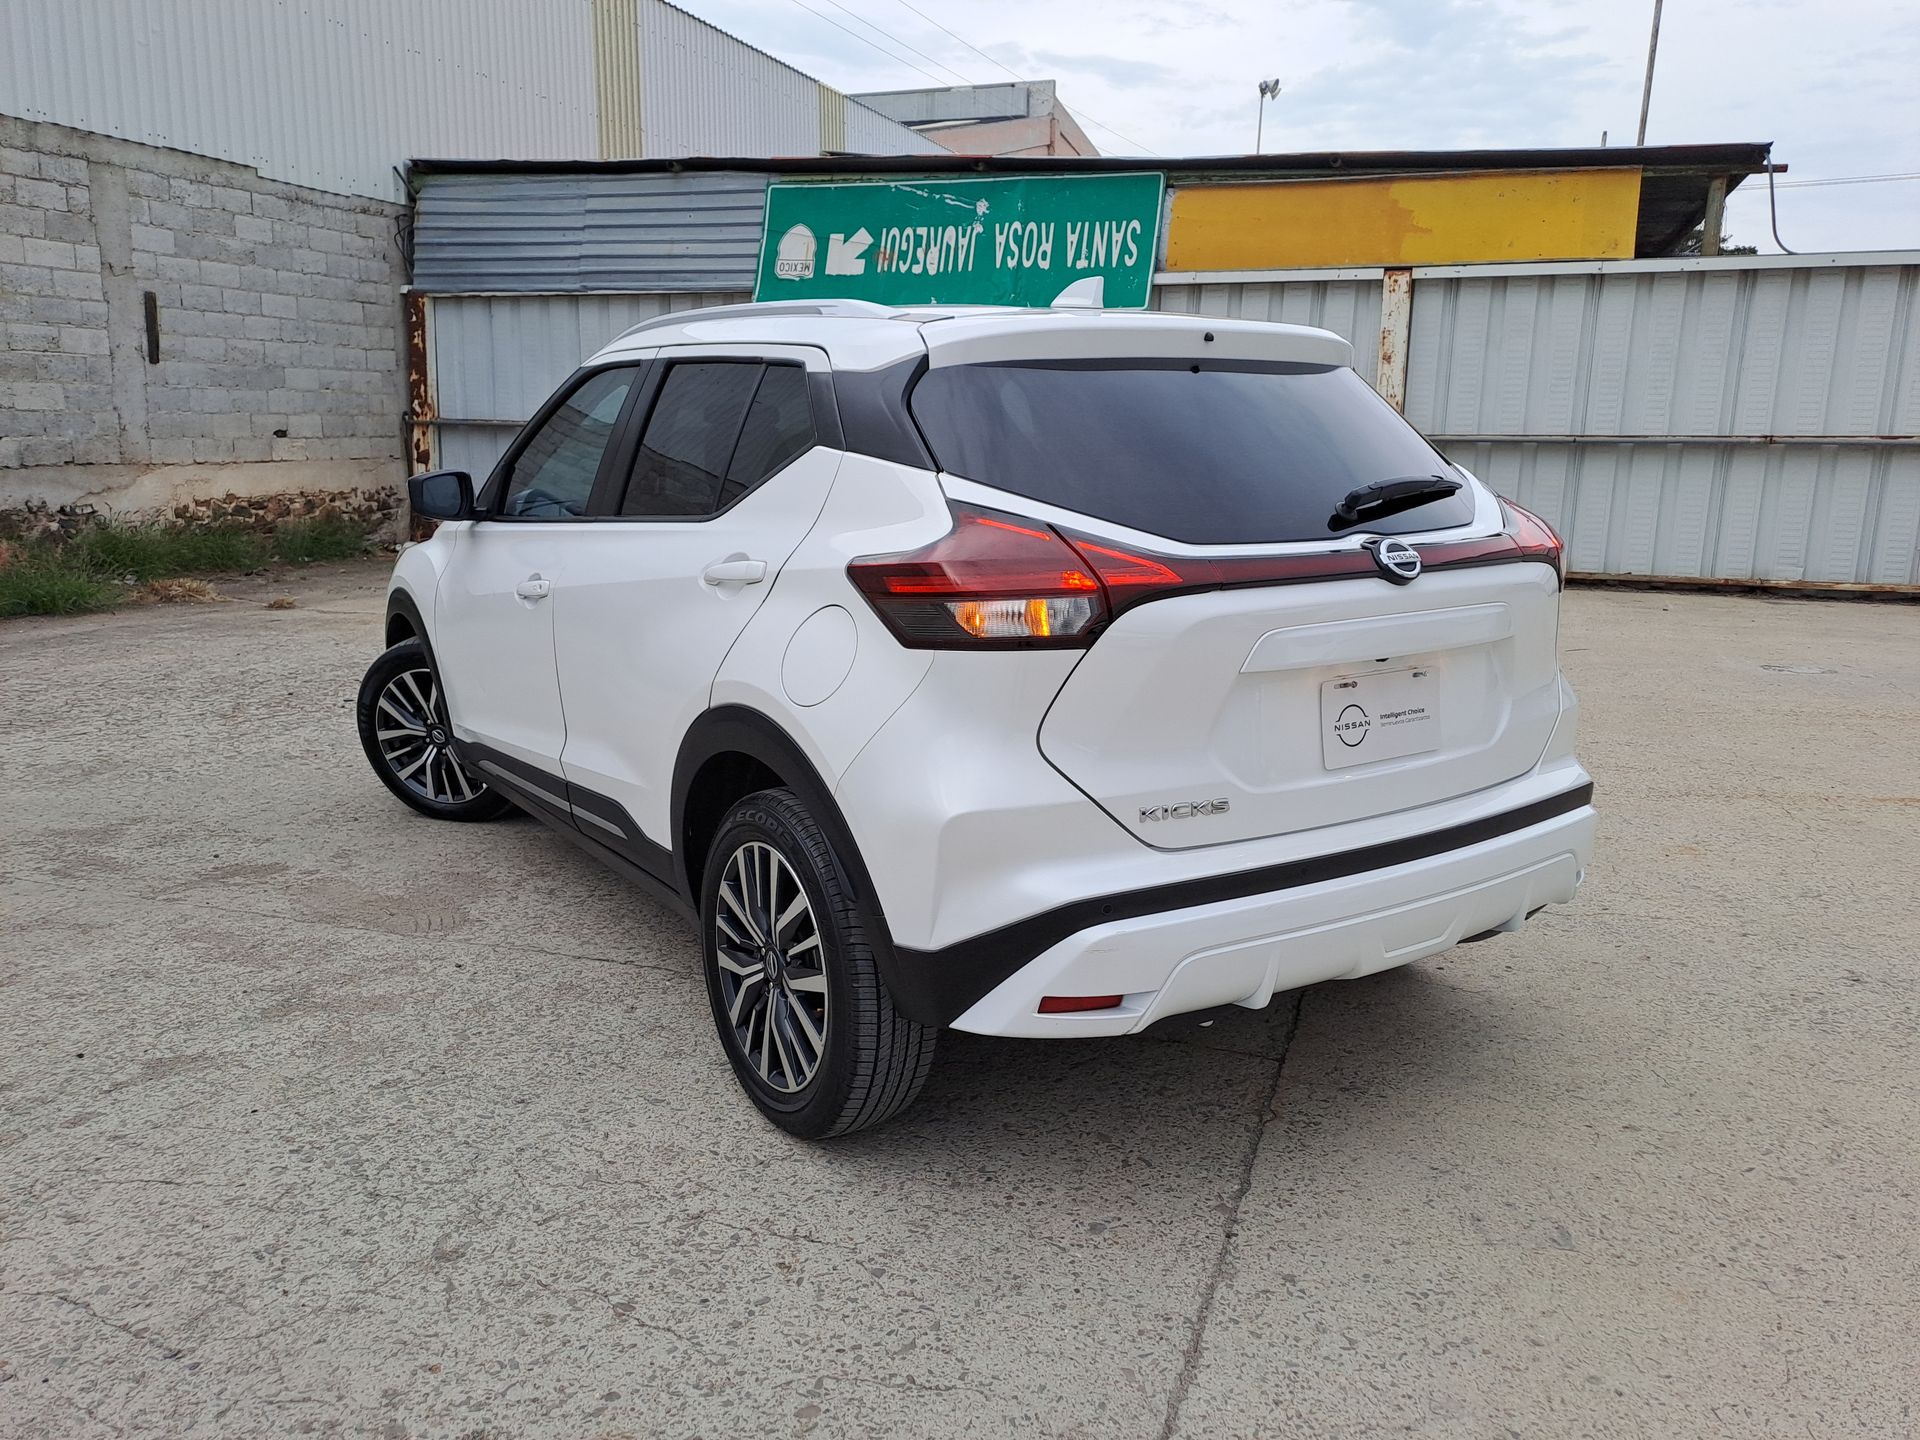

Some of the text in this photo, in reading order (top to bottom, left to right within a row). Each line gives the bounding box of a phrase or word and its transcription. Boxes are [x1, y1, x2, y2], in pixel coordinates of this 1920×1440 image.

[877, 219, 1141, 276] SANTA ROSA JAUREGUI
[779, 262, 811, 273] MEXICO
[1386, 552, 1419, 562] NISSAN
[1379, 706, 1426, 720] Intelligent Choice
[1334, 719, 1371, 732] NISSAN
[1138, 797, 1230, 823] KICKS
